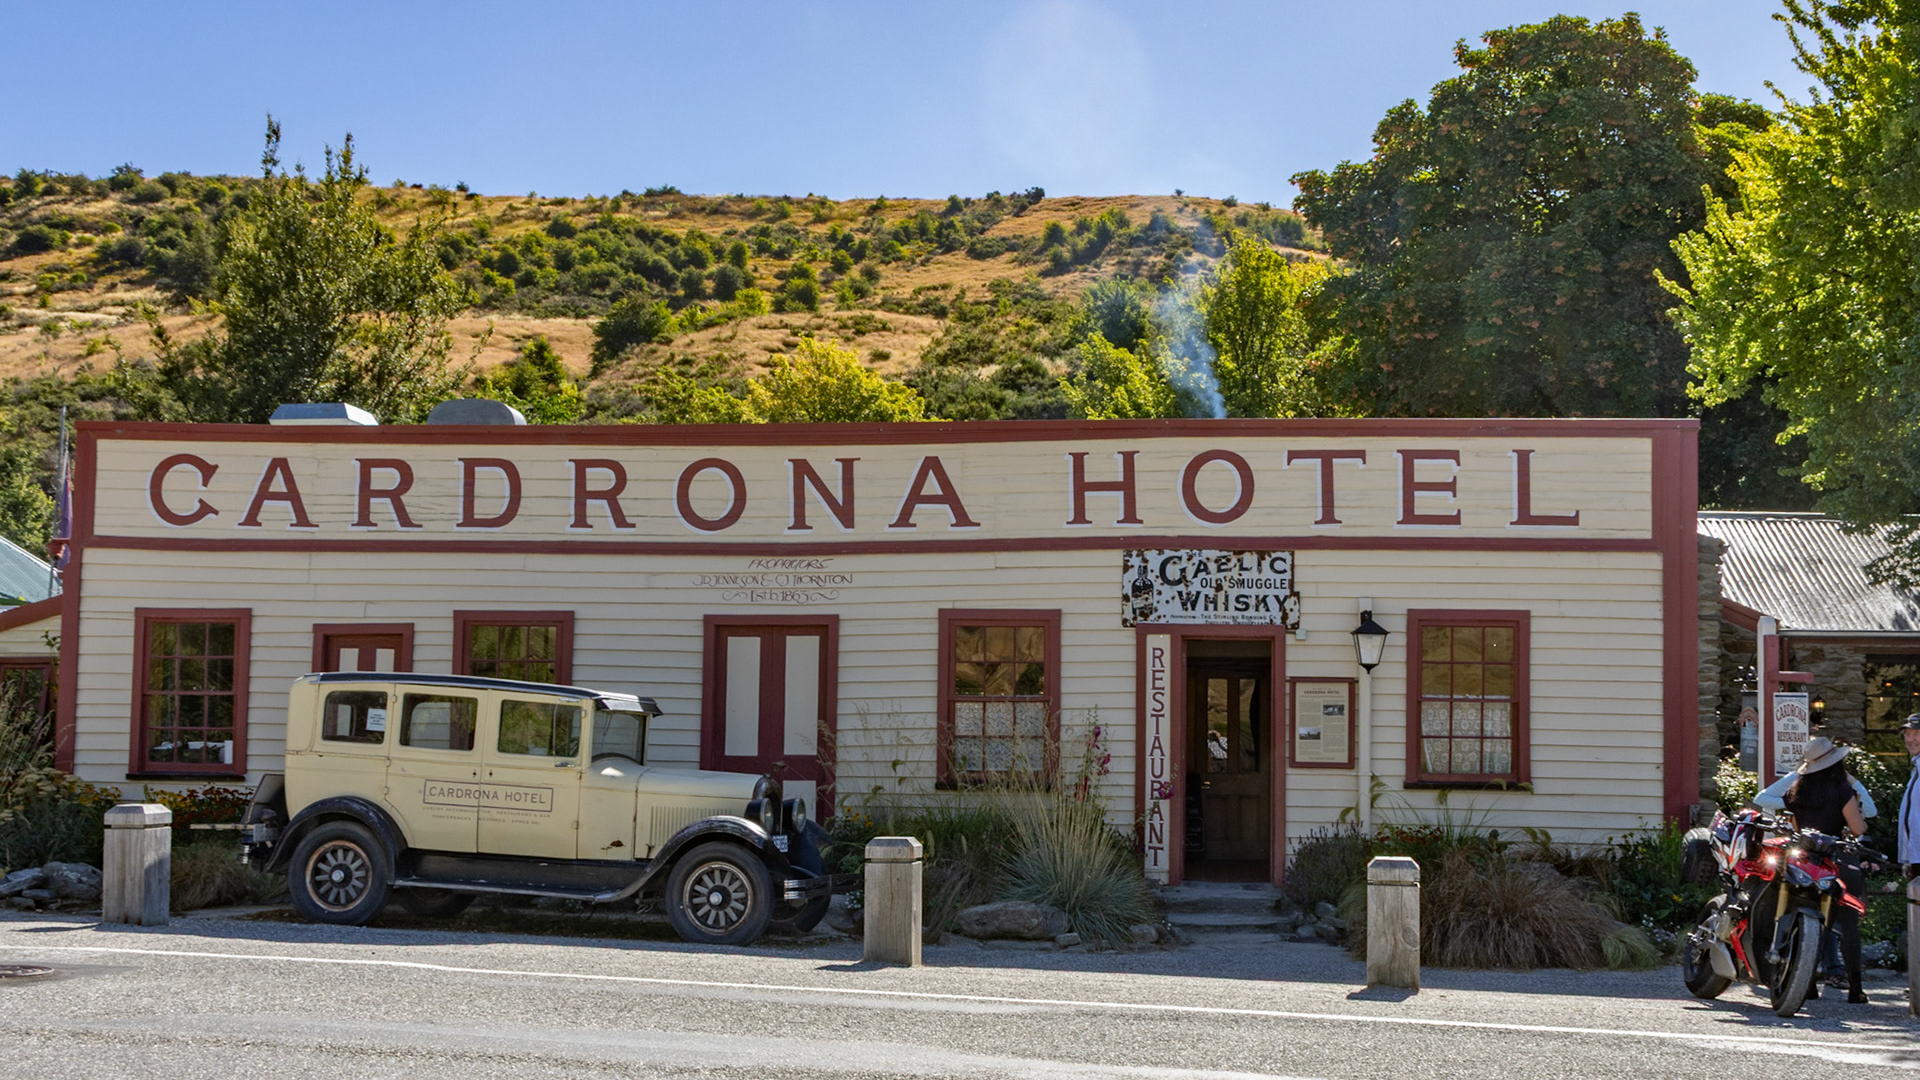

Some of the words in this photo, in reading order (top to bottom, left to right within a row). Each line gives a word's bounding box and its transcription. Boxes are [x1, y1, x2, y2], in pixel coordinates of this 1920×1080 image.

[147, 452, 982, 532] CARDRONA
[1064, 448, 1581, 530] HOTEL
[792, 572, 853, 588] THORNTON
[1159, 553, 1289, 587] GAELIC
[1228, 577, 1292, 590] SMUGGLE
[781, 589, 810, 604] 1863
[1176, 590, 1290, 613] WHISKY
[1775, 703, 1807, 726] CARDRONA
[1776, 731, 1807, 743] RESTAURANT
[1148, 646, 1166, 867] RESTAURANT
[428, 786, 500, 801] CARDRONA
[504, 791, 546, 805] HOTEL
